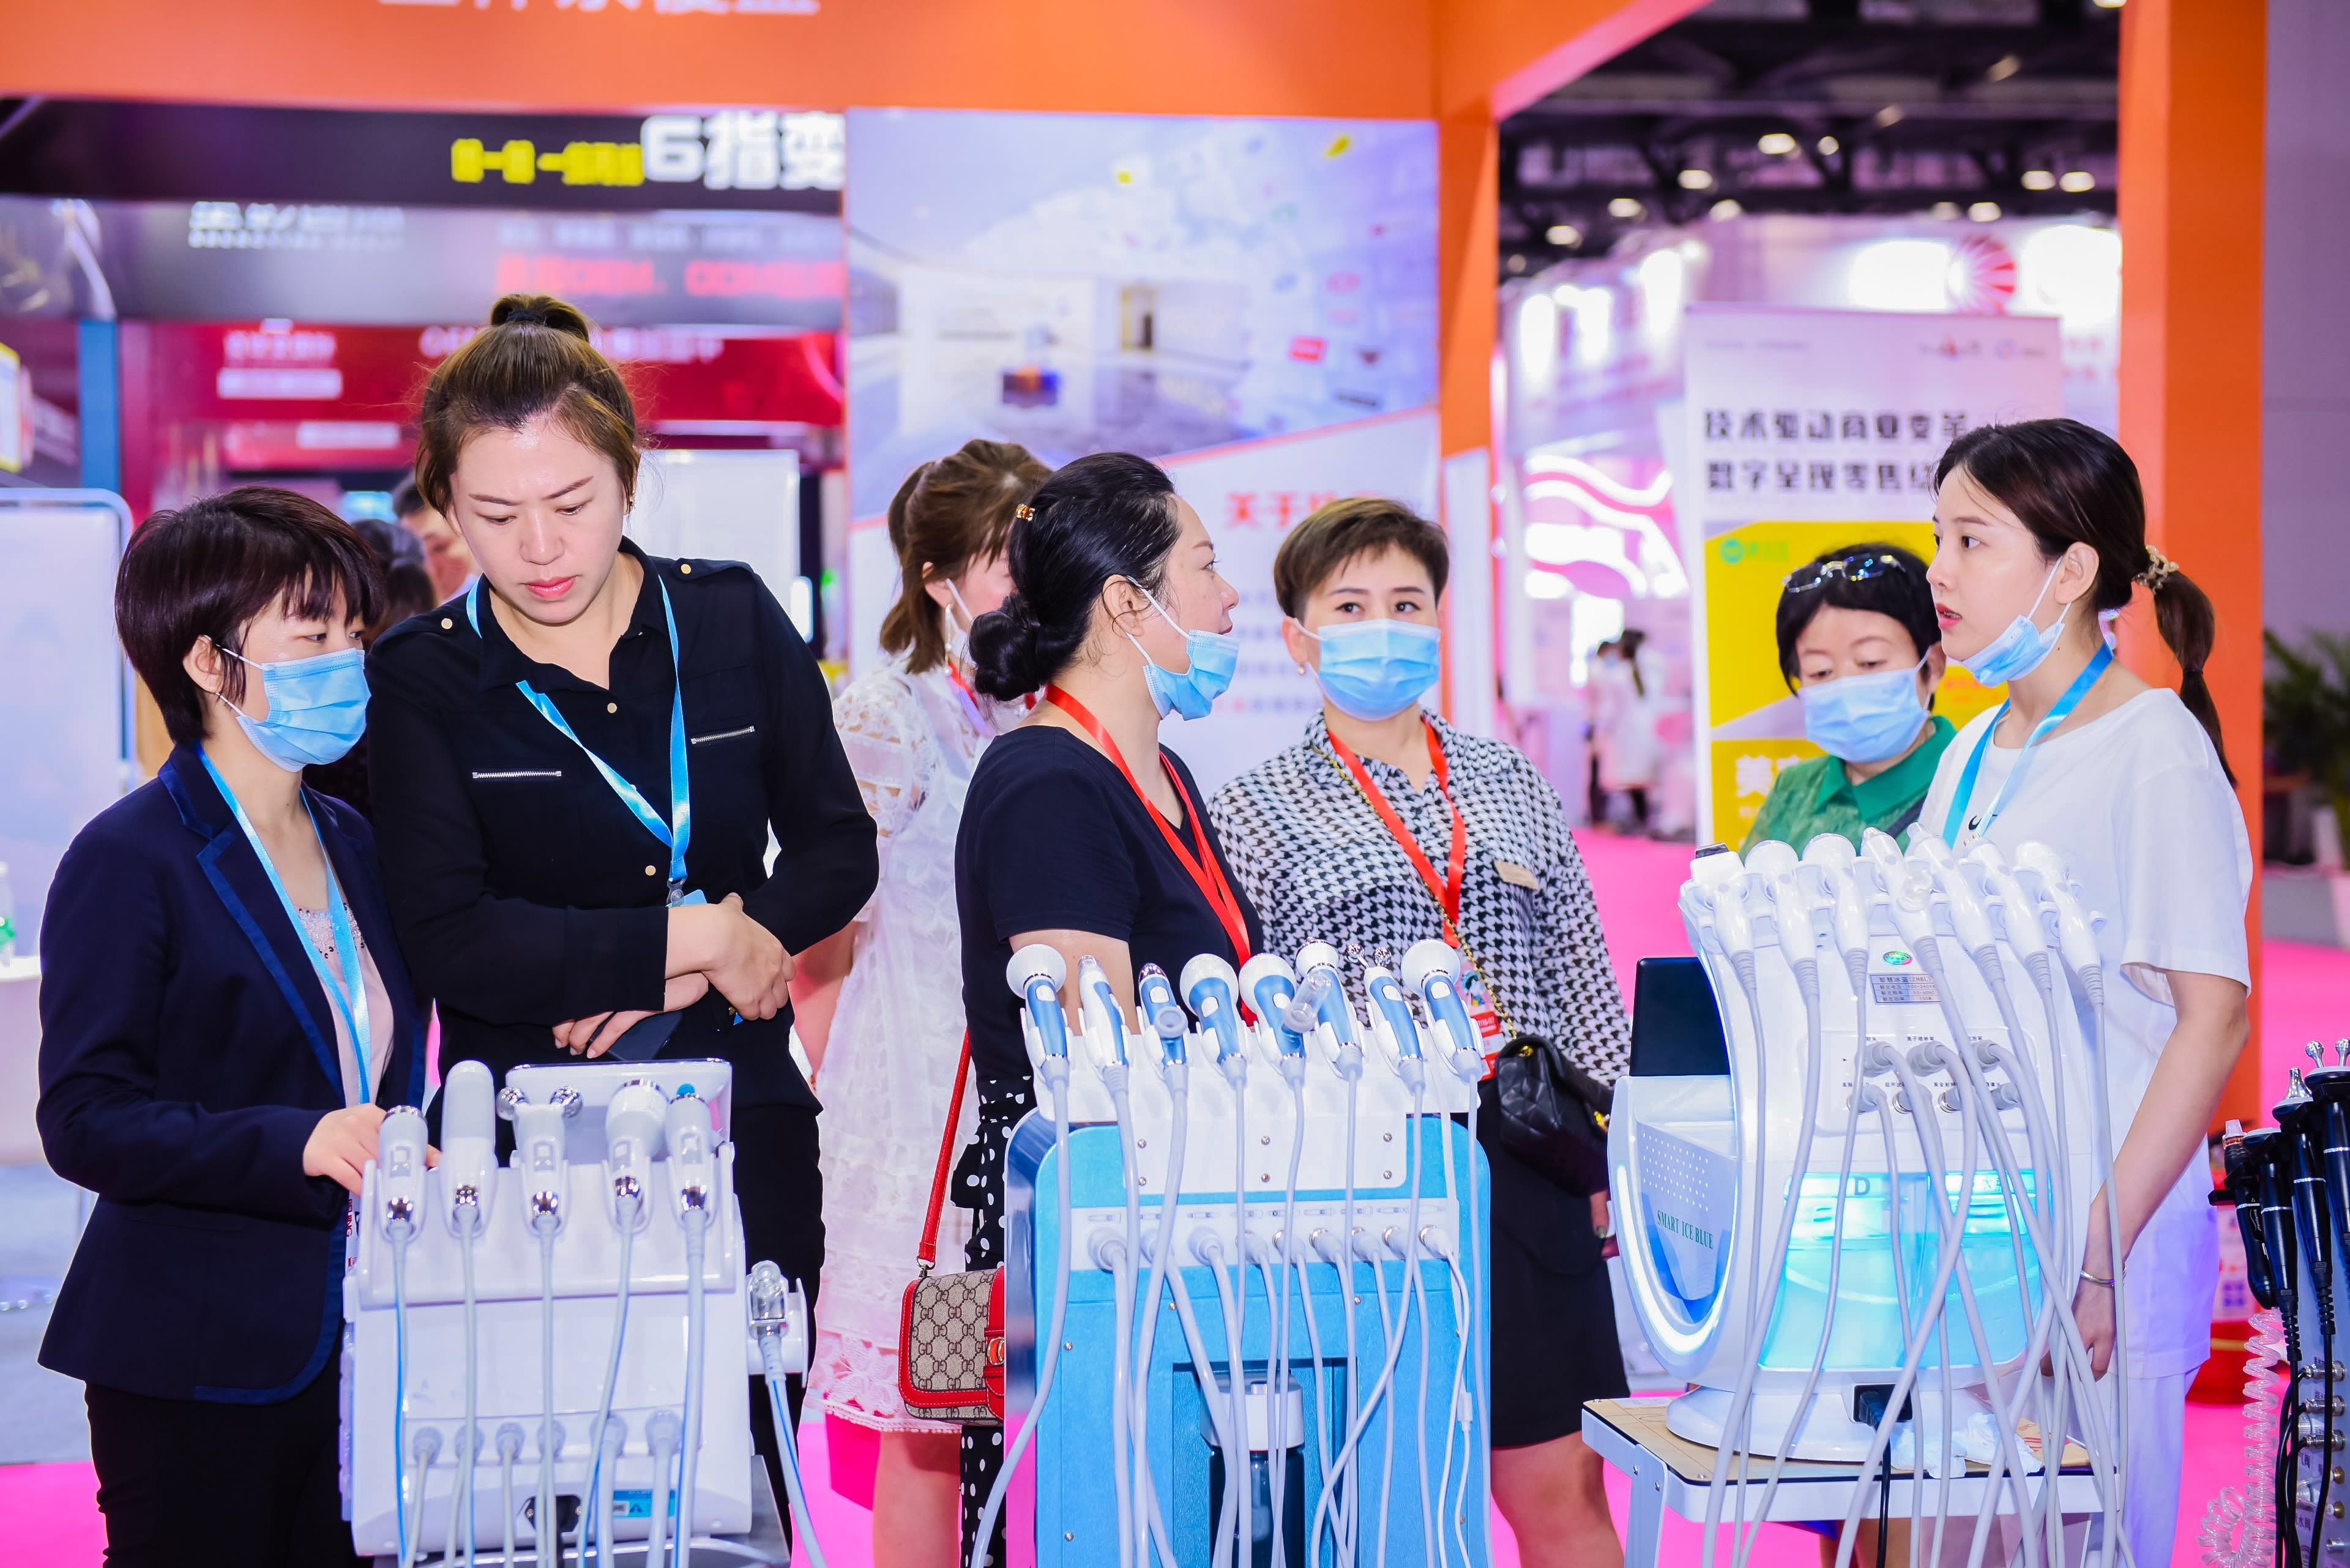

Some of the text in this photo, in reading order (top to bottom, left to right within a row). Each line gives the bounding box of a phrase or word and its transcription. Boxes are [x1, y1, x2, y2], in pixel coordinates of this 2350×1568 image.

[1657, 1209, 1713, 1249] SMART ICE BLUE
